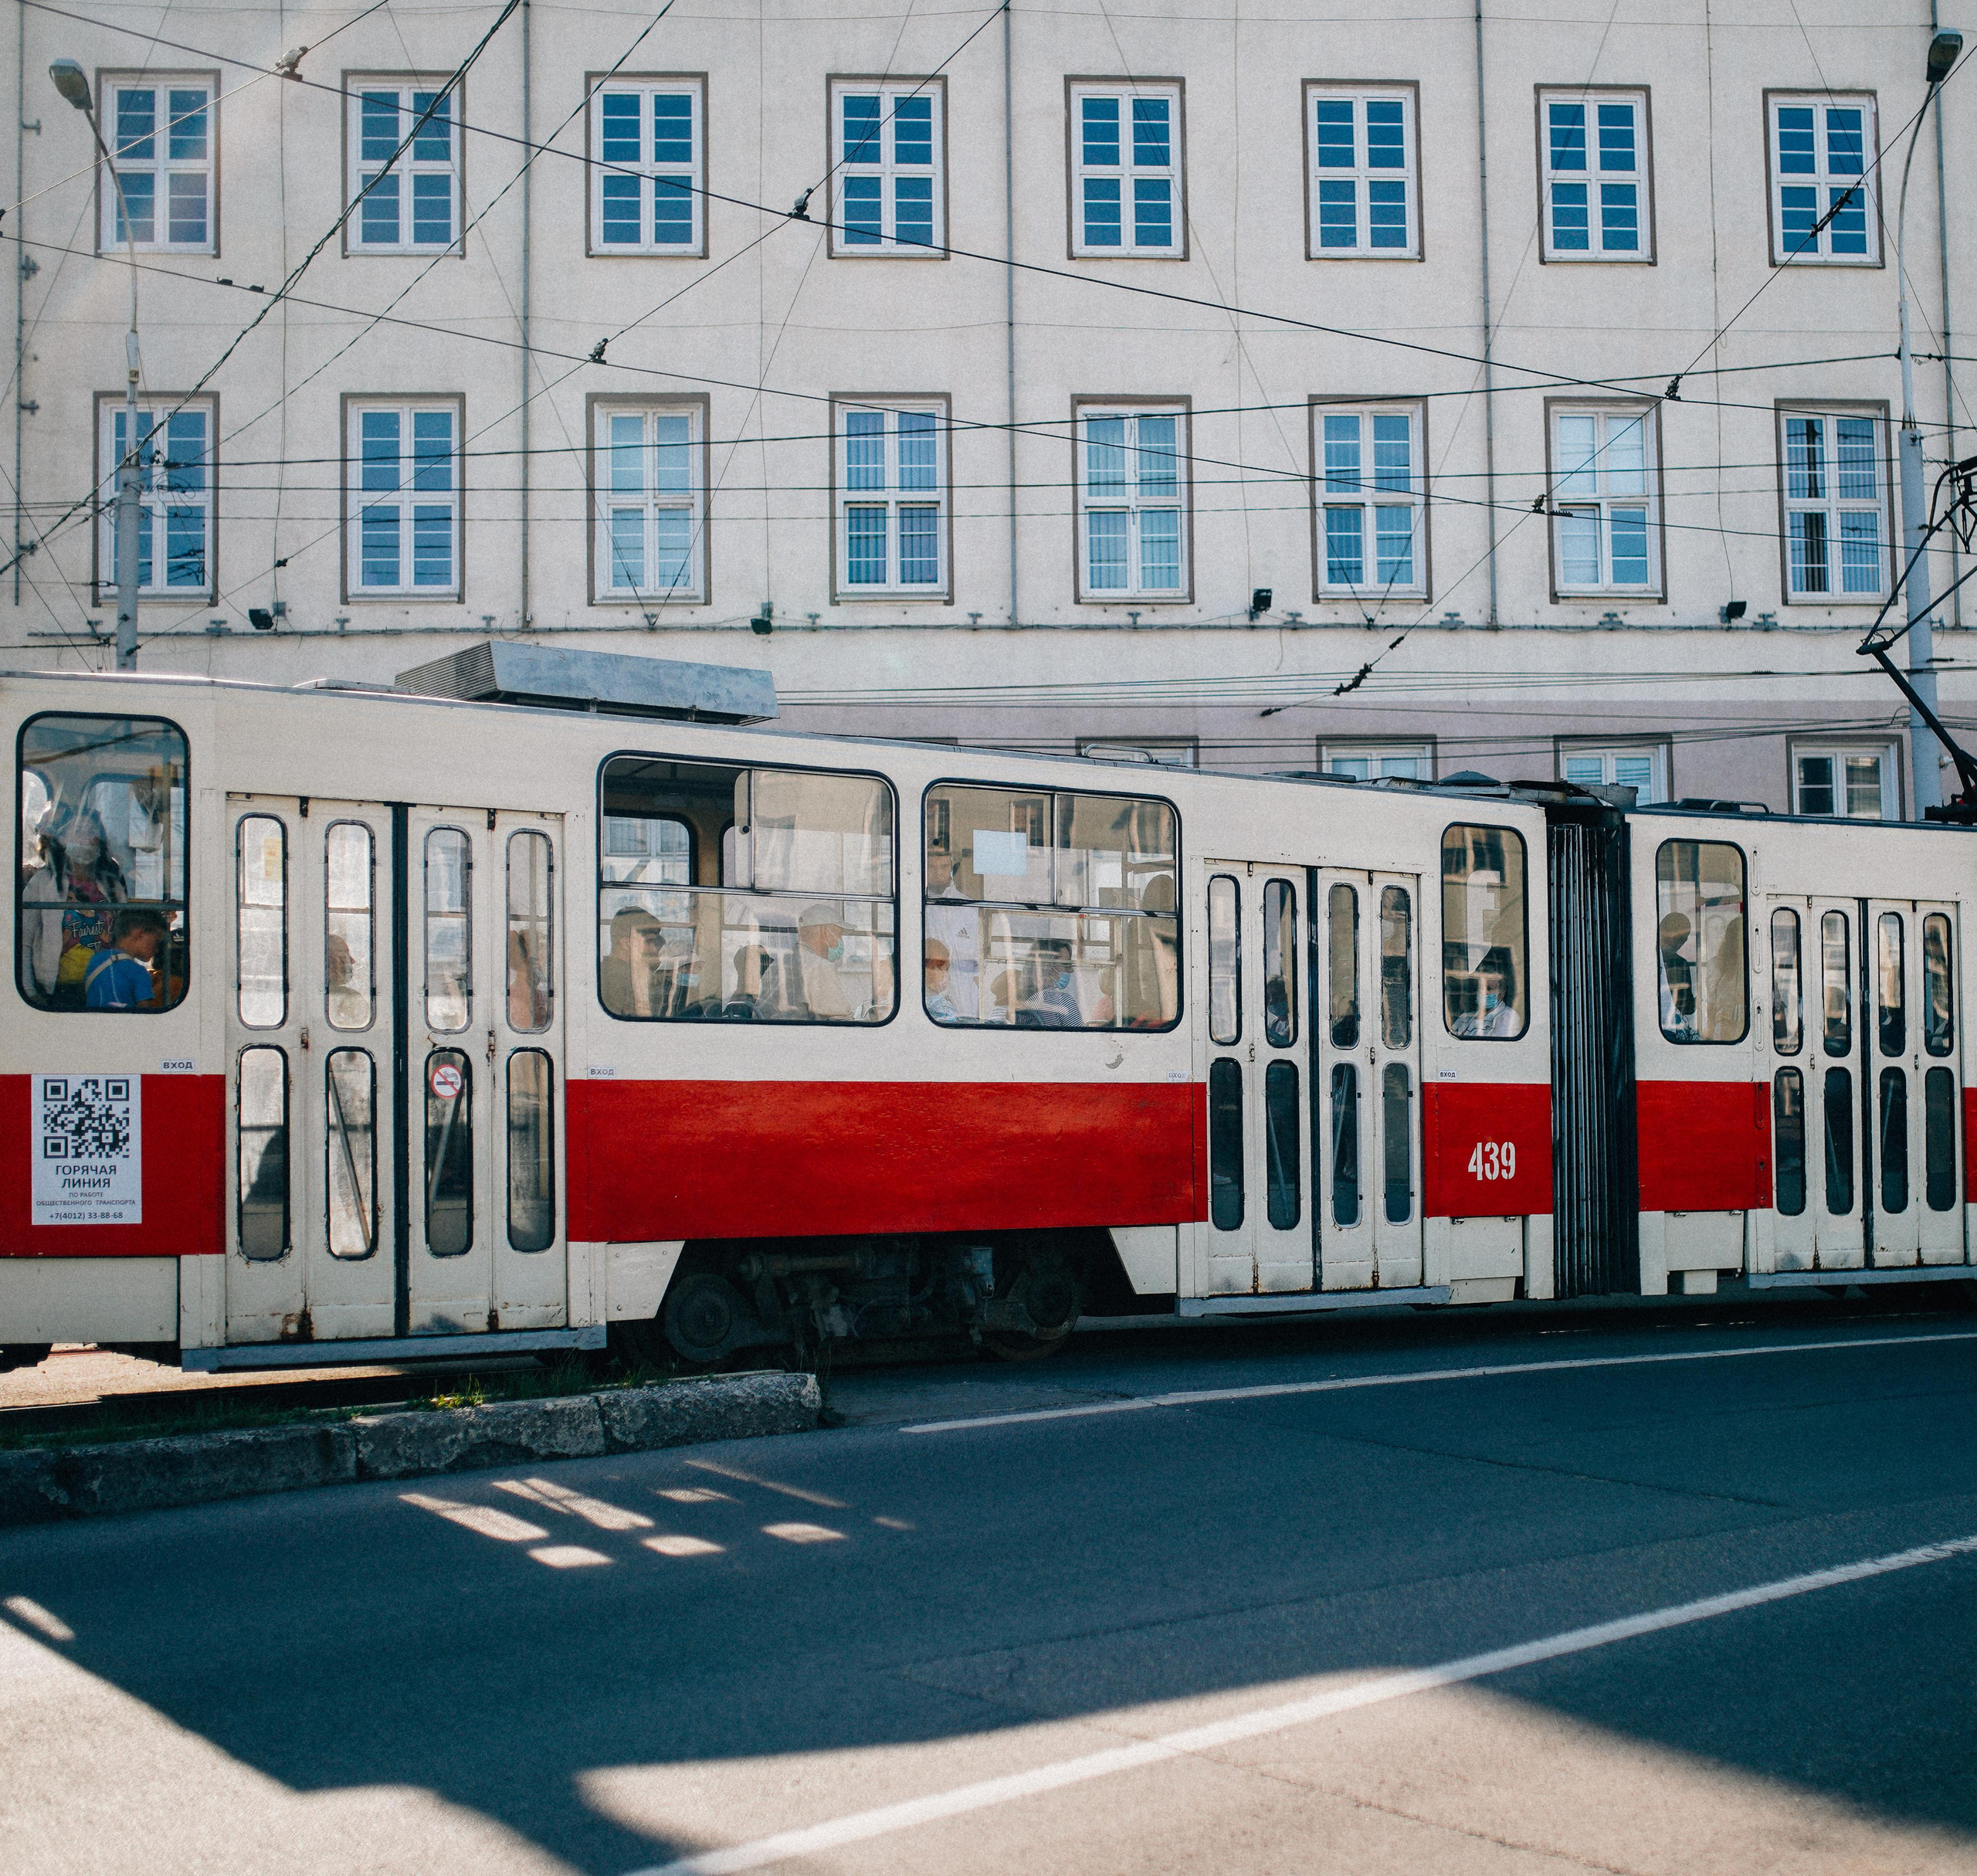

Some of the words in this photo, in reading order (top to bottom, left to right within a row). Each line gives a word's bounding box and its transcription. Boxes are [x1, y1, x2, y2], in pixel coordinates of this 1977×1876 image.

[163, 1061, 193, 1070] ВХОД
[1467, 1142, 1516, 1181] 439
[55, 1165, 117, 1175] ГОРЯЧАЯ
[61, 1178, 110, 1188] ЛИНИЯ
[49, 1212, 86, 1220] +7(4012)
